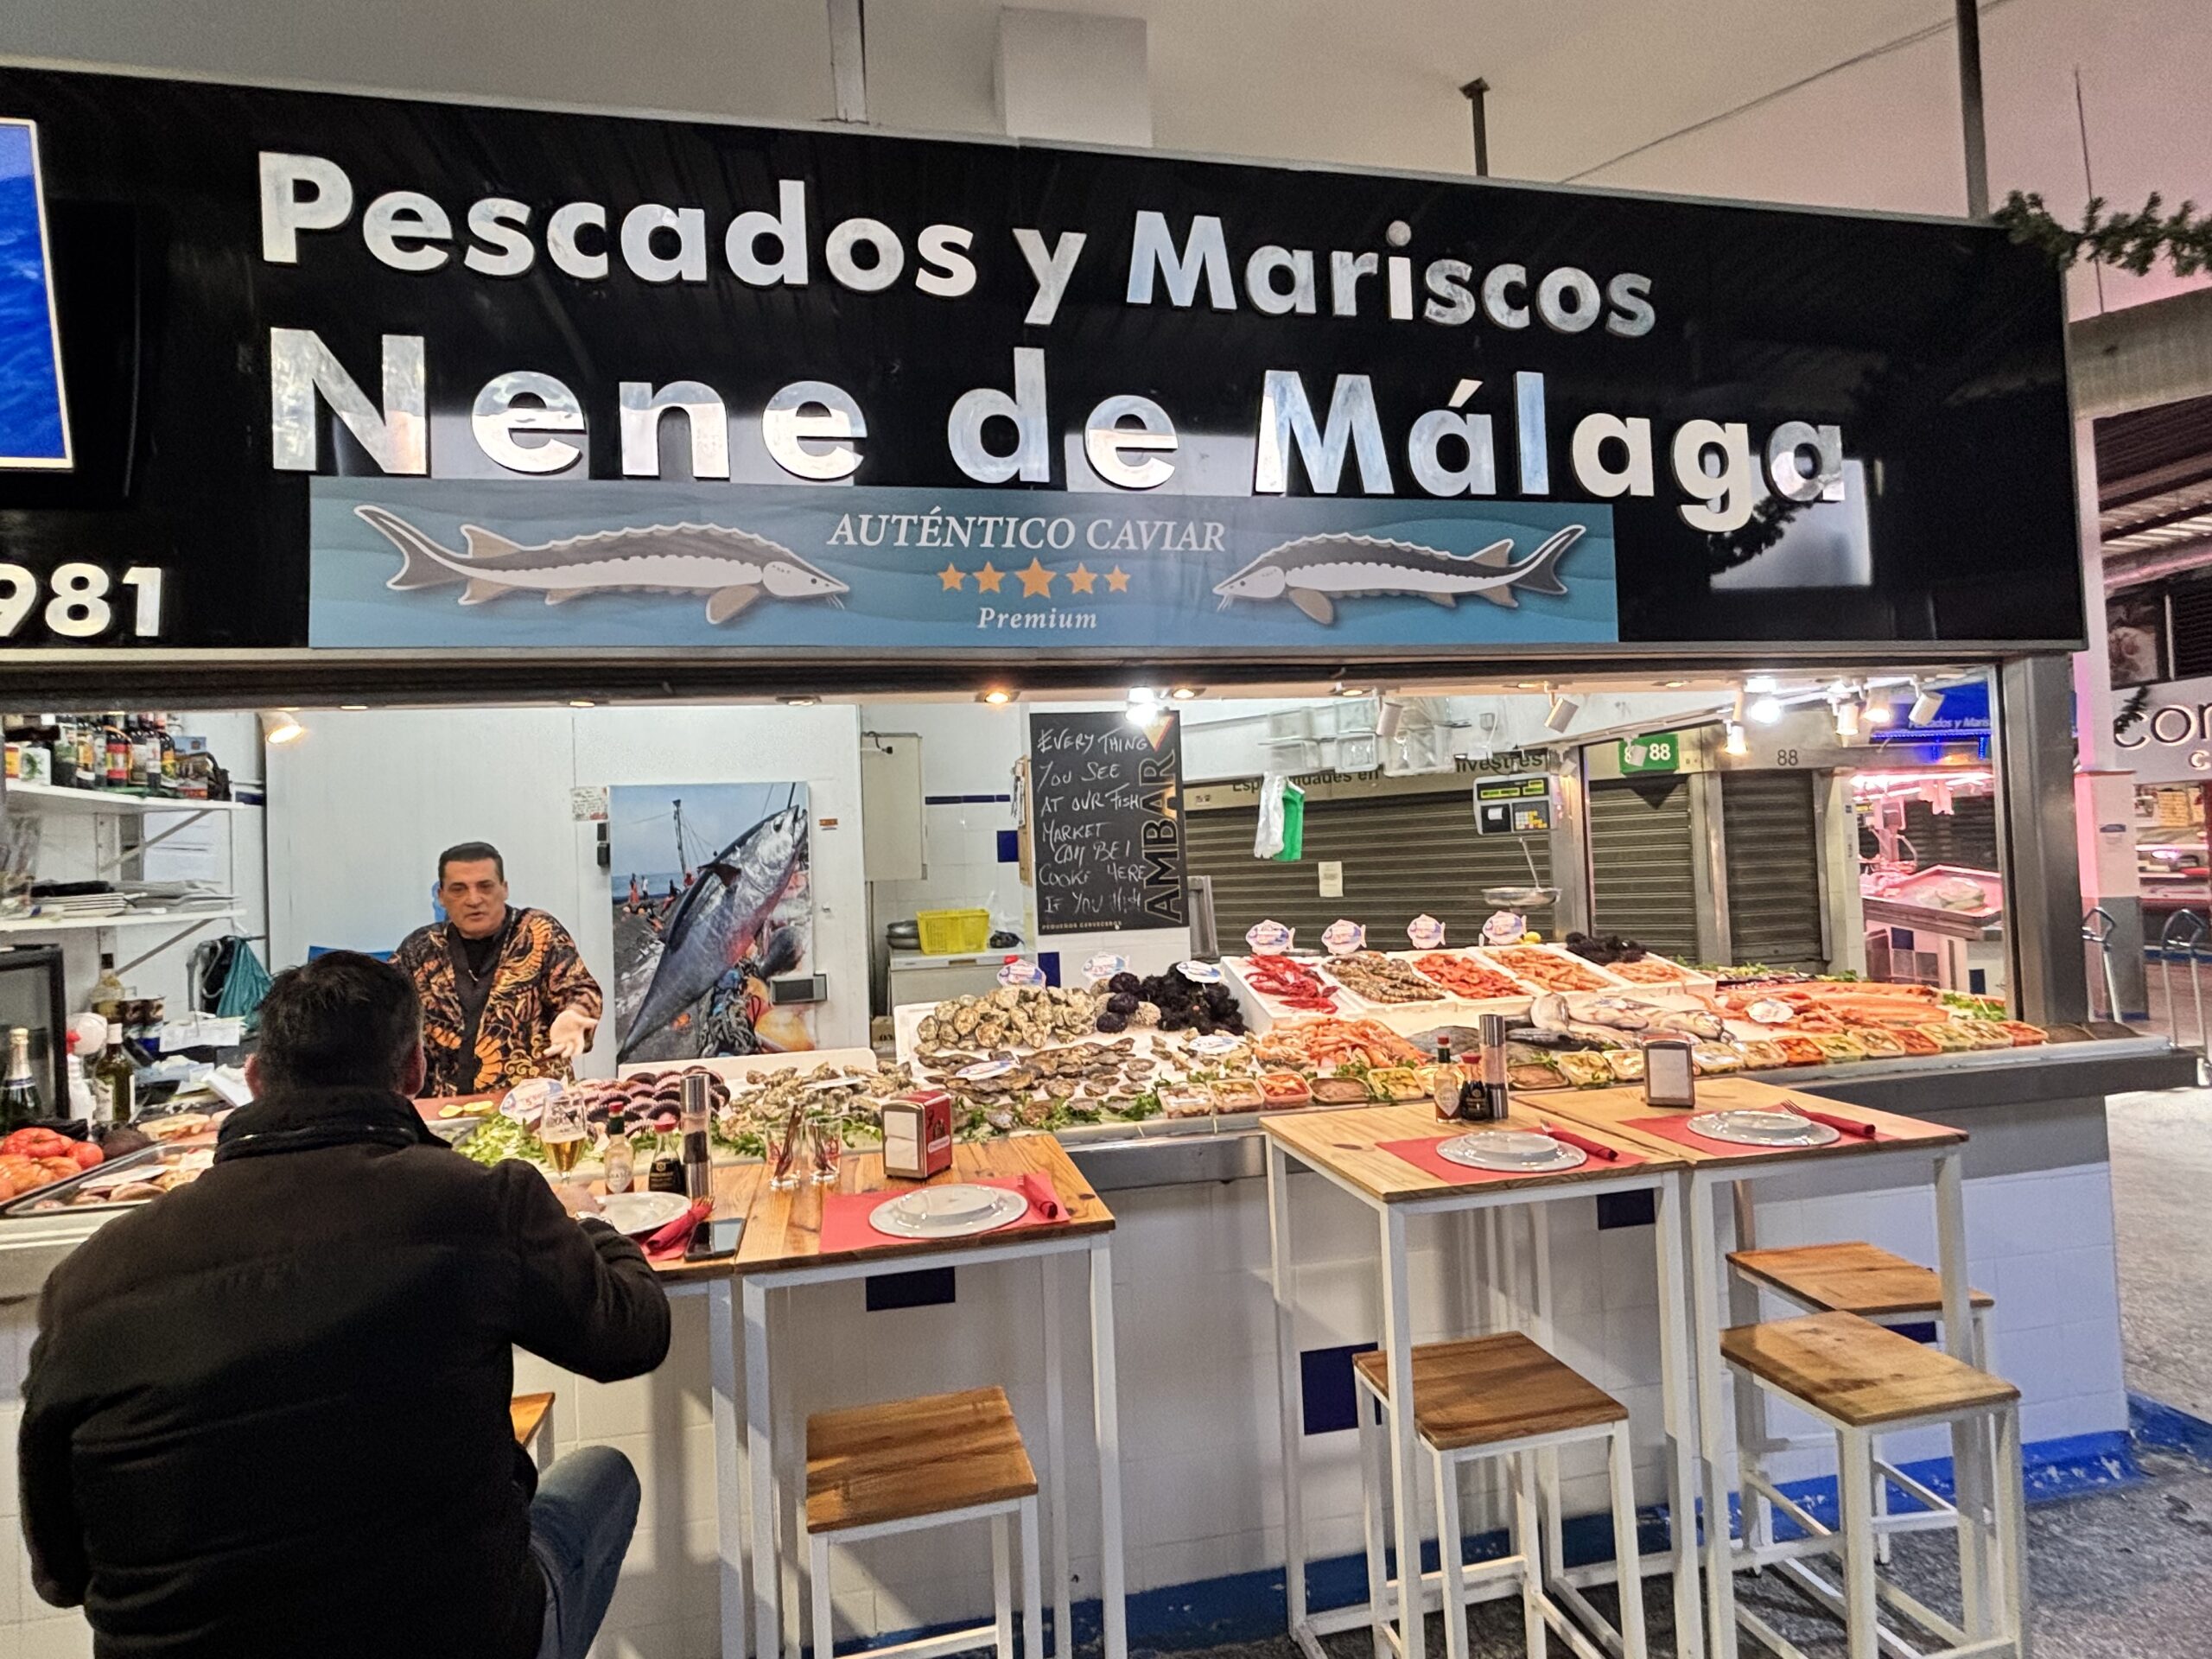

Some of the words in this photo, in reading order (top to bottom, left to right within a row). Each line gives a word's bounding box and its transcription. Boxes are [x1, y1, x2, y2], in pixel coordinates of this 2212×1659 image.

[259, 152, 977, 297] Pescados
[1014, 229, 1087, 325] y
[1127, 211, 1656, 336] Mariscos
[270, 327, 868, 482] Nene
[948, 347, 1179, 489] de
[1255, 370, 1846, 537] Málaga
[826, 505, 1076, 550] AUTÉNTICO
[1086, 518, 1226, 553] CAVIAR
[976, 607, 1097, 630] Premium
[1649, 742, 1671, 761] 88
[1777, 749, 1798, 766] 88
[1037, 760, 1071, 793] YOU
[1081, 761, 1121, 781] SEE
[1040, 796, 1065, 817] AT
[1071, 789, 1106, 811] OUR
[1105, 782, 1140, 810] FISH
[1042, 819, 1112, 852] MARKET
[1093, 841, 1121, 861] BE
[1138, 749, 1183, 924] AMBAR
